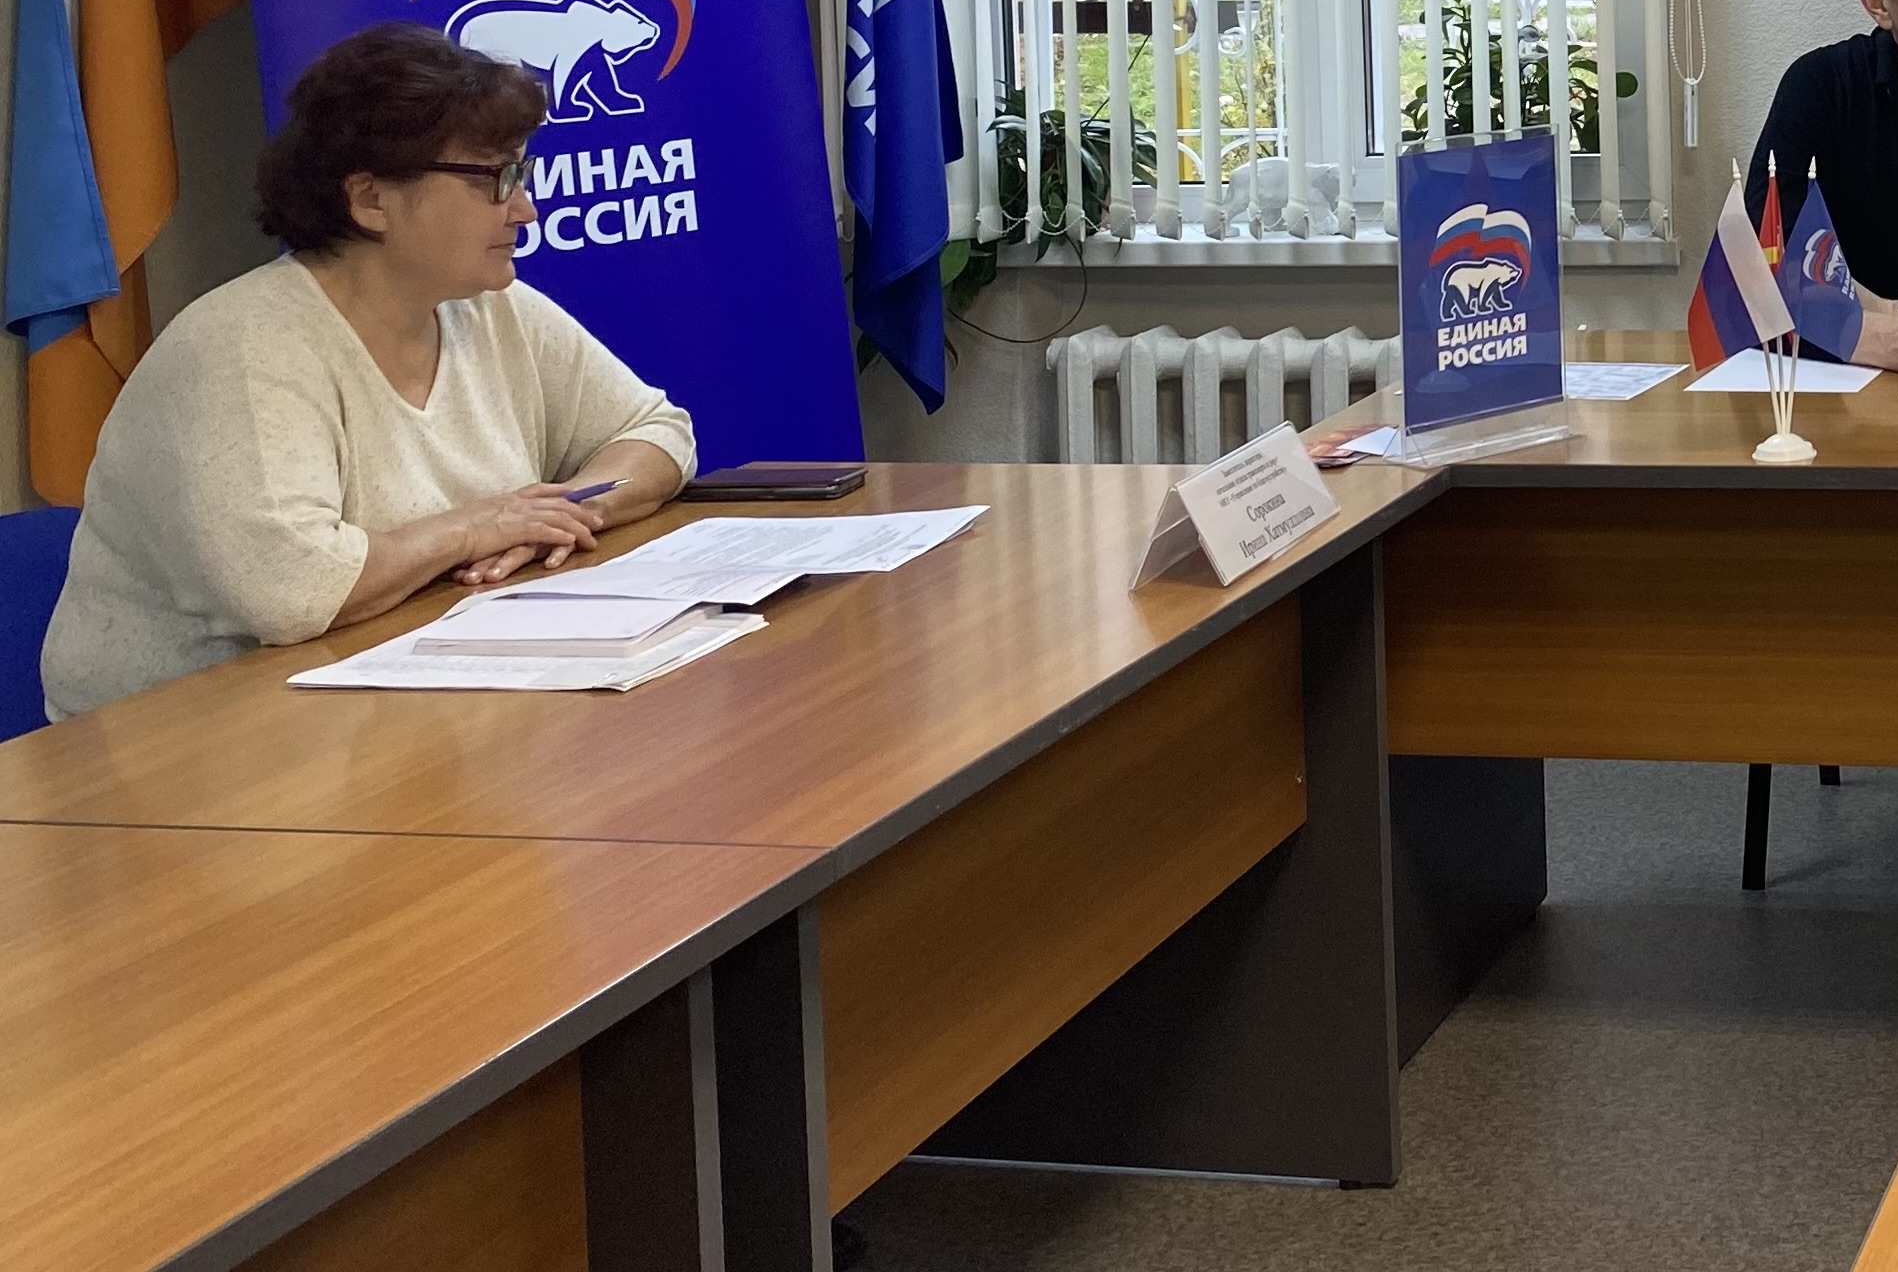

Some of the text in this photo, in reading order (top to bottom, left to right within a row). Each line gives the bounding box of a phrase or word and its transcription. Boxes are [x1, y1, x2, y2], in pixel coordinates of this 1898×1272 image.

[526, 138, 696, 204] ИНАЯ
[512, 190, 699, 258] ОССИЯ
[1438, 312, 1526, 347] ЕДИНАЯ
[1438, 335, 1527, 371] РОССИЯ
